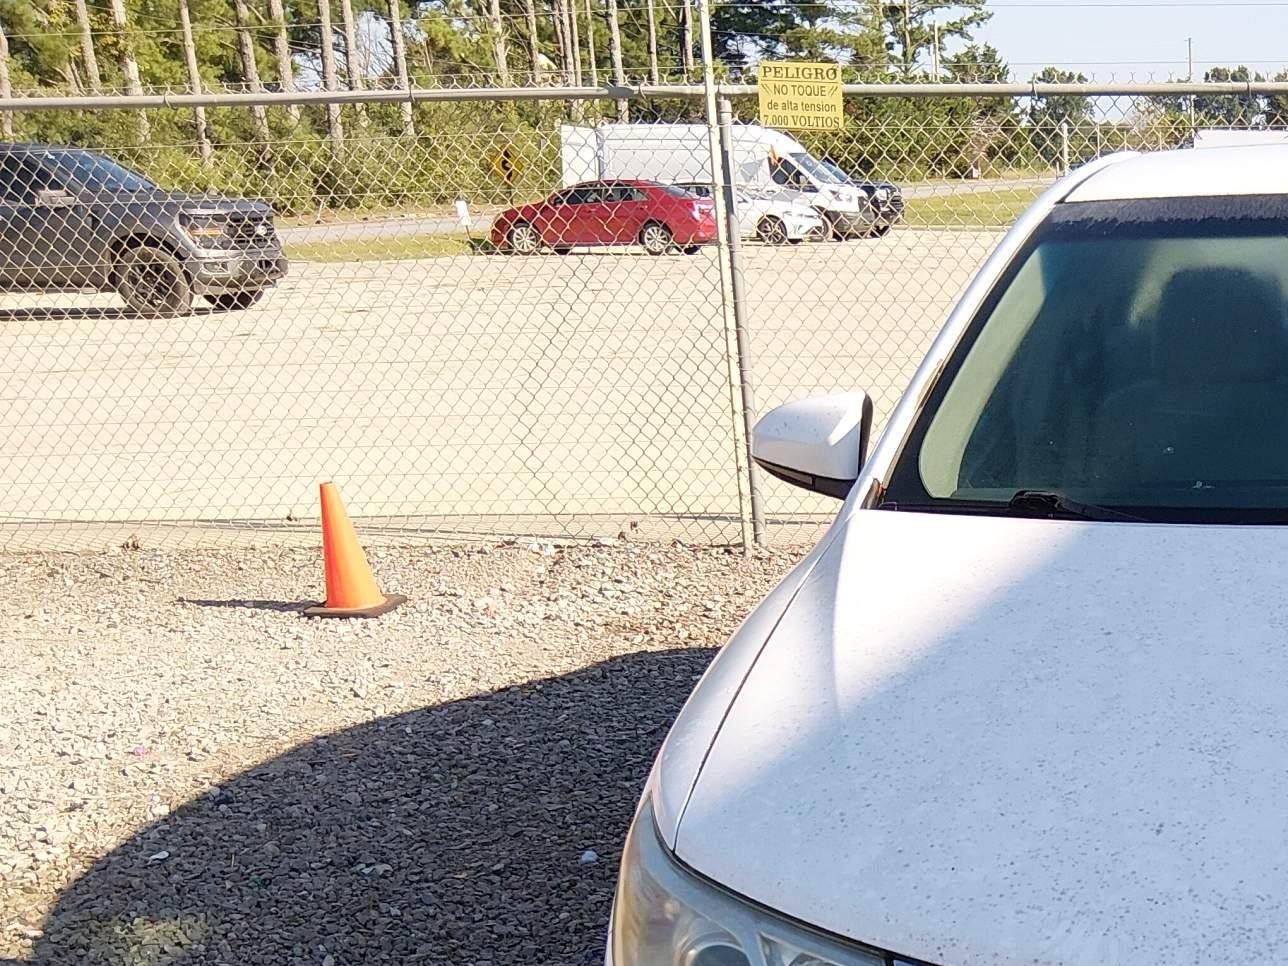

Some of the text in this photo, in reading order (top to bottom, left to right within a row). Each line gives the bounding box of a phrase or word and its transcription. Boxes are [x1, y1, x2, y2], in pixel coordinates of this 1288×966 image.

[762, 66, 837, 80] PELIGRO
[773, 84, 827, 97] NO TOQUE
[767, 99, 837, 112] de alta tension
[791, 116, 840, 128] VOLTIOS
